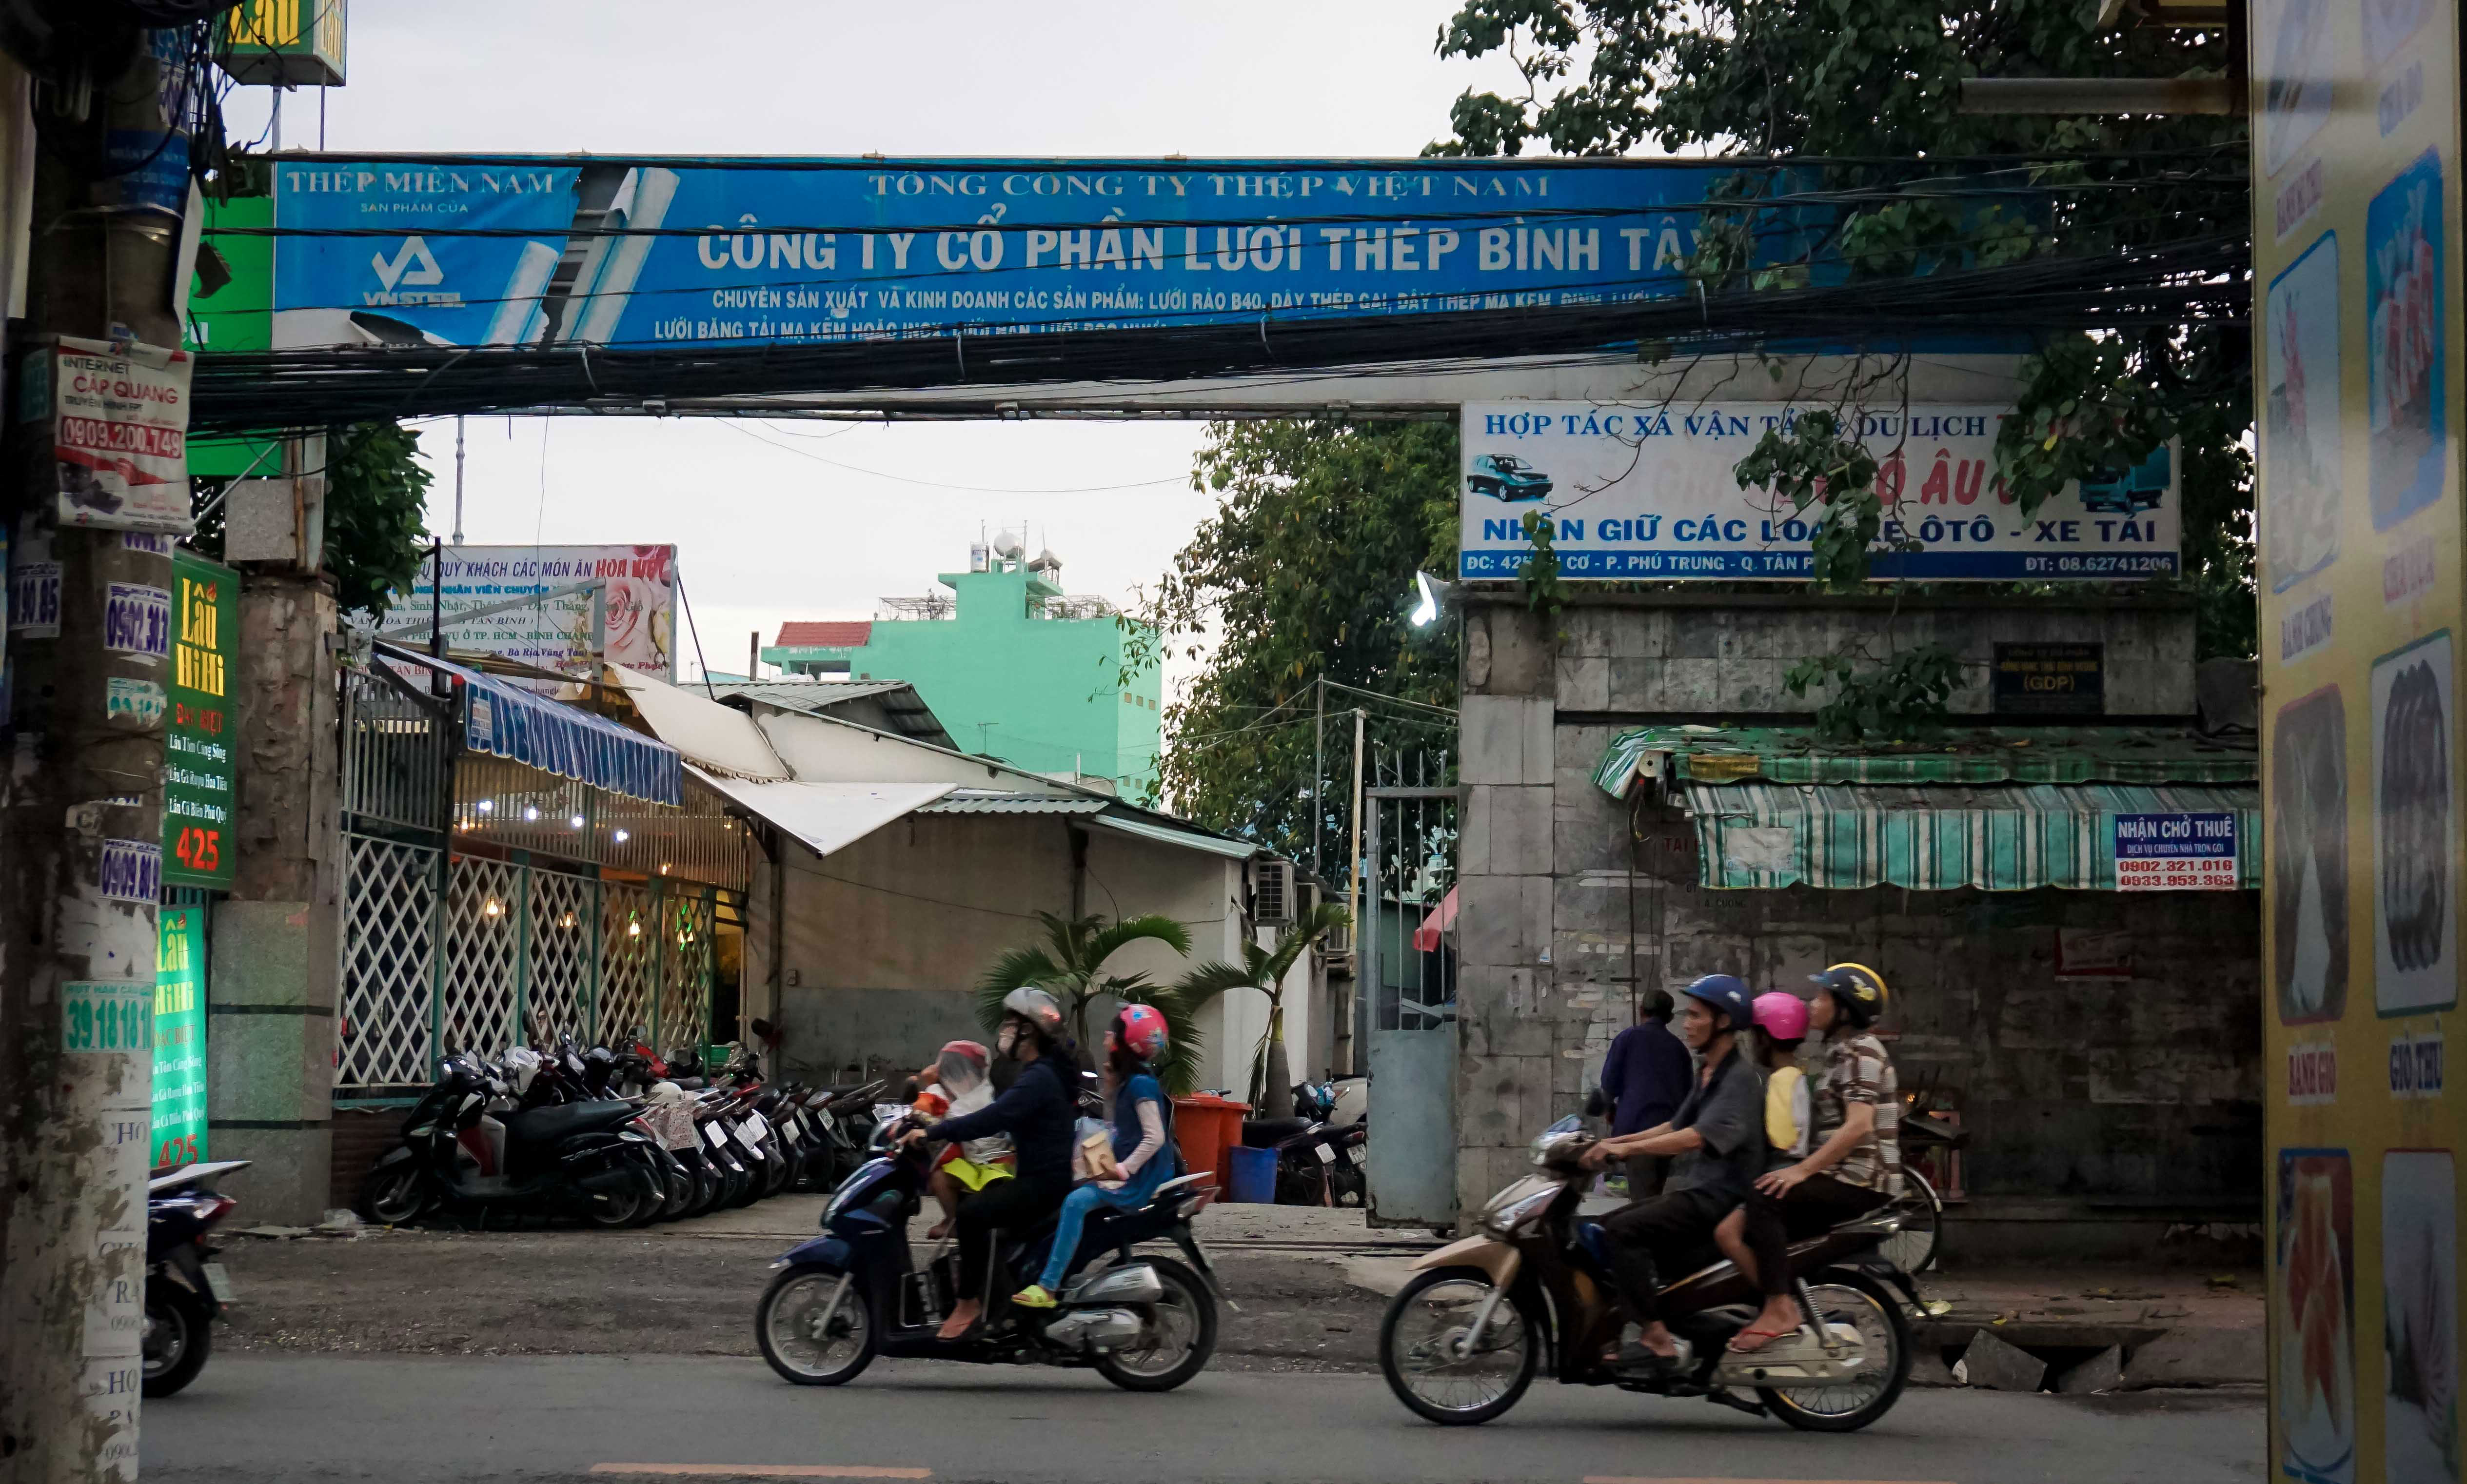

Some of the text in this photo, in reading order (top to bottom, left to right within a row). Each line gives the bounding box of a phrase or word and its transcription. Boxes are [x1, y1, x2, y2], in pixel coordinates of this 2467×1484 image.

[287, 167, 377, 193] THÉP
[481, 173, 553, 194] NAM
[1003, 171, 1124, 196] CÔNG
[1138, 176, 1193, 196] TY
[1206, 172, 1322, 199] THÉP
[1331, 172, 1439, 201] VIỆT
[1454, 176, 1549, 197] NAM
[699, 213, 835, 270] CÔNG
[859, 225, 915, 270] TY
[937, 203, 1006, 271] CỔ
[1026, 207, 1163, 271] PHẦN
[1320, 221, 1459, 271] THÉP
[1479, 218, 1599, 271] BÌNH
[713, 287, 781, 309] CHUYÊN
[787, 284, 819, 309] SẢN
[825, 283, 868, 309] XUẤT
[906, 291, 947, 309] KINH
[952, 291, 1009, 309] DOANH
[1014, 285, 1048, 309] CÁC
[1053, 285, 1086, 309] SẢN
[1149, 287, 1186, 310] LƯỚI
[655, 316, 692, 339] LƯỚI
[698, 317, 743, 339] BĂNG
[63, 357, 130, 375] INTERNET
[114, 381, 178, 404] QUANG
[1485, 411, 1552, 439] HỢP
[1562, 410, 1623, 436] TÁC
[1634, 410, 1673, 436] XÃ
[1685, 410, 1750, 440] VẬN
[1760, 408, 1799, 435] TẢ
[1861, 416, 1902, 437] DU
[1912, 416, 1987, 441] LỊCH
[1598, 514, 1663, 542] GIỮ
[1674, 514, 1747, 542] CÁC
[1919, 514, 1995, 542] ÔTÔ
[2034, 520, 2081, 542] XE
[466, 558, 508, 578] KHÁCH
[513, 558, 537, 577] CÁC
[541, 558, 571, 577] MÓN
[574, 559, 592, 577] ĂN
[595, 558, 627, 578] HOA
[1467, 556, 1495, 570] ĐC:
[1567, 553, 1591, 570] CƠ
[1606, 556, 1622, 570] P.
[1628, 552, 1661, 570] PHÚ
[1668, 555, 1725, 571] TRUNG
[1763, 553, 1797, 570] TÂN
[493, 632, 517, 640] HCM
[2118, 814, 2232, 841] NHẬN CHỞ THUÊ
[176, 827, 220, 871] 425
[158, 1134, 199, 1168] 425
